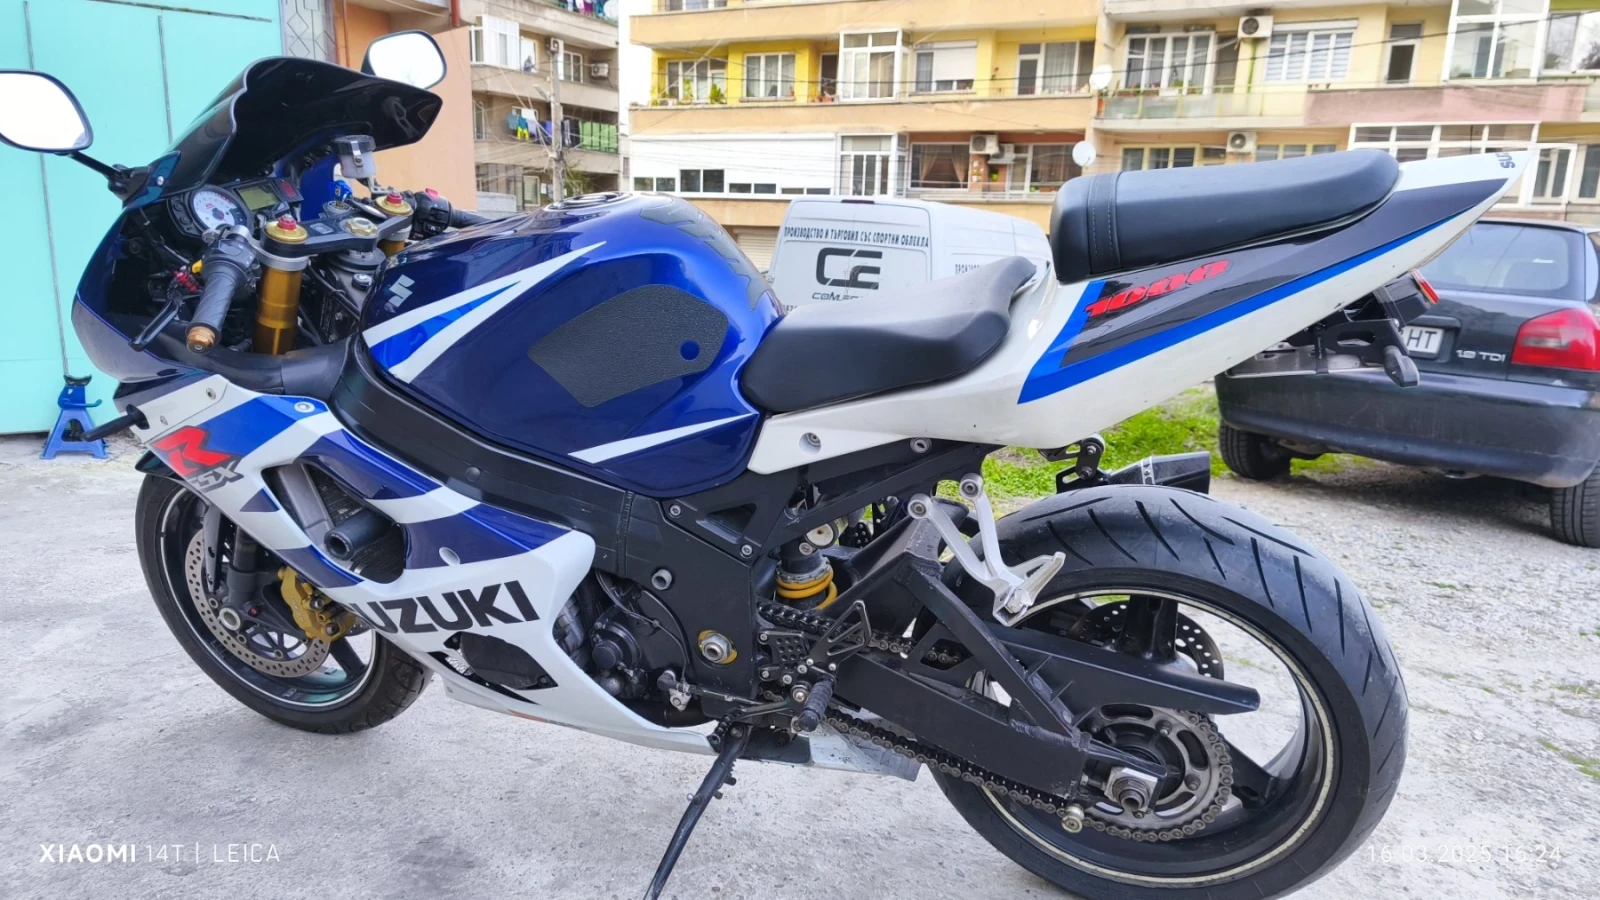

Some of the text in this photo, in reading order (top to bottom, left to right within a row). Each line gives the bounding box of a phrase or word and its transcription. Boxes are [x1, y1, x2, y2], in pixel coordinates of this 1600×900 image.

[784, 226, 929, 248] ПРОИЗВОДСТВО И ТЪРГОВИЯ СЪС СПОРТНИ ОБЛЕКЛА
[1085, 260, 1230, 317] 1000
[1479, 351, 1506, 362] TDI
[347, 580, 540, 634] UZUKI
